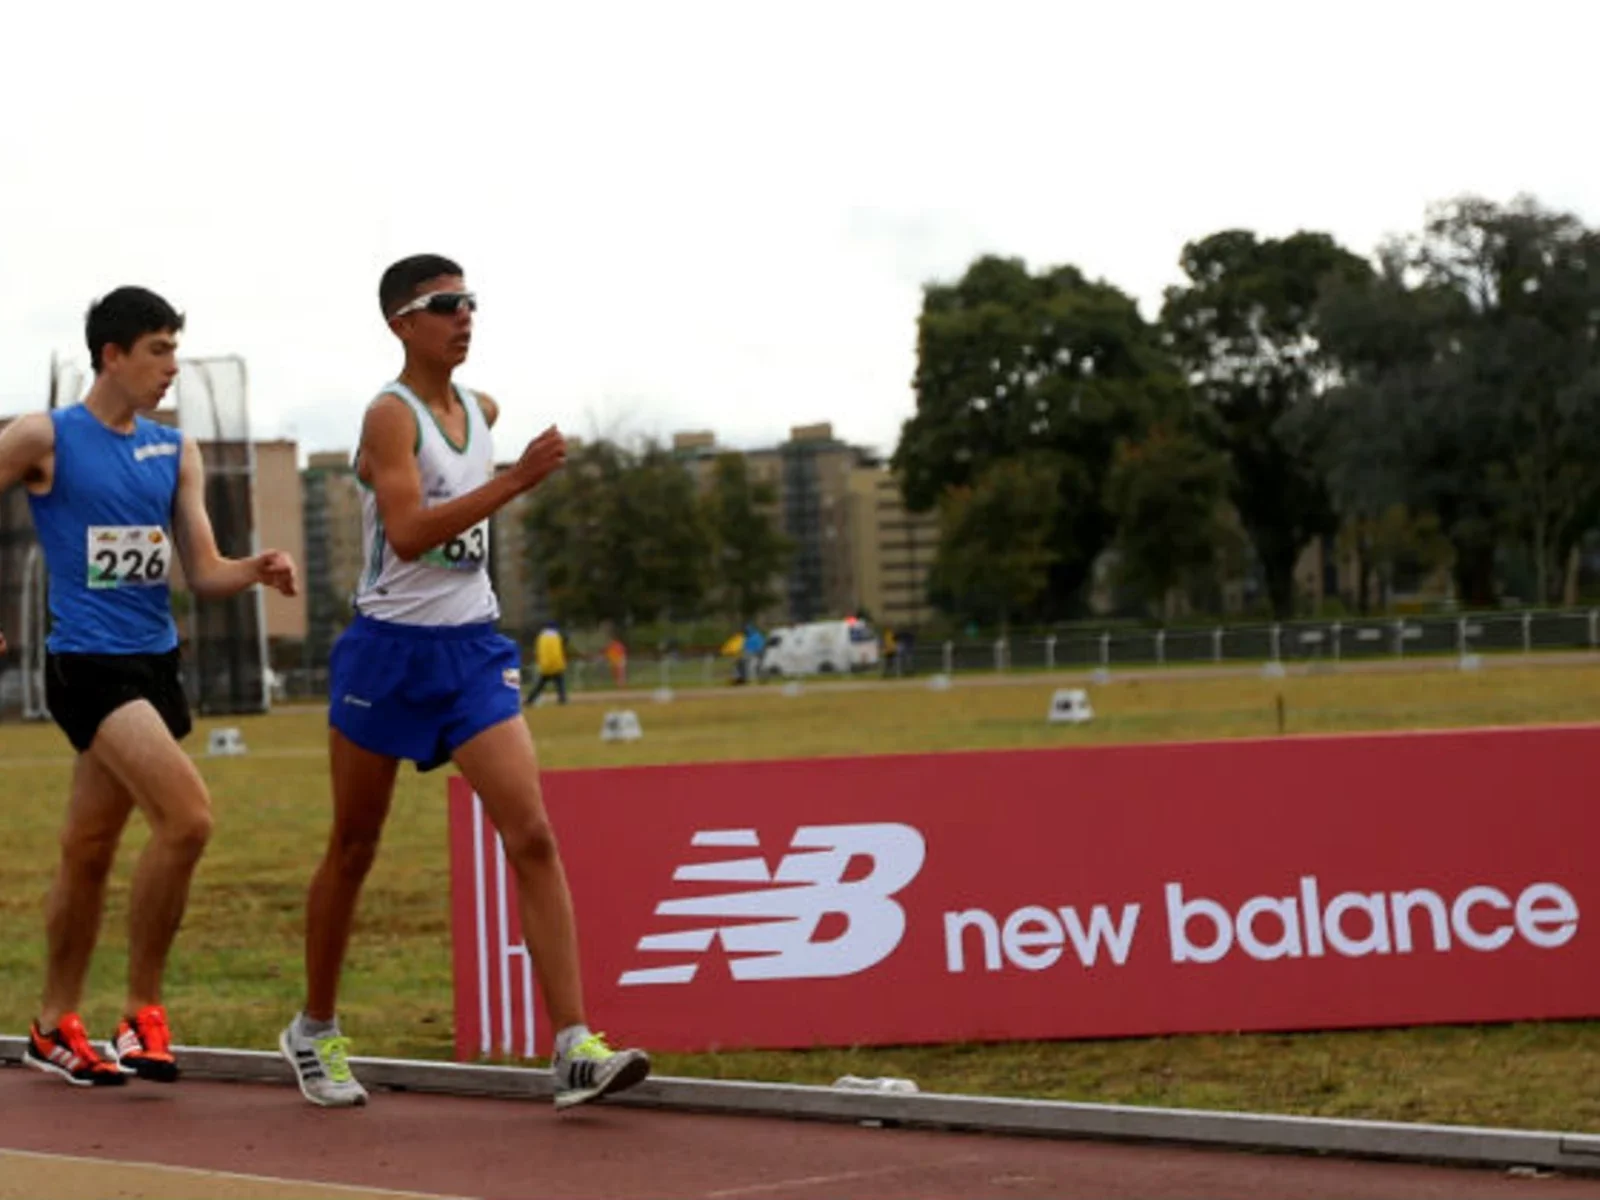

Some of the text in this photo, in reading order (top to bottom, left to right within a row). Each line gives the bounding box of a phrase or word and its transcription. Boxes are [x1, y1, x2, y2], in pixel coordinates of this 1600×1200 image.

[95, 548, 164, 581] 226
[943, 876, 1579, 972] new balance
